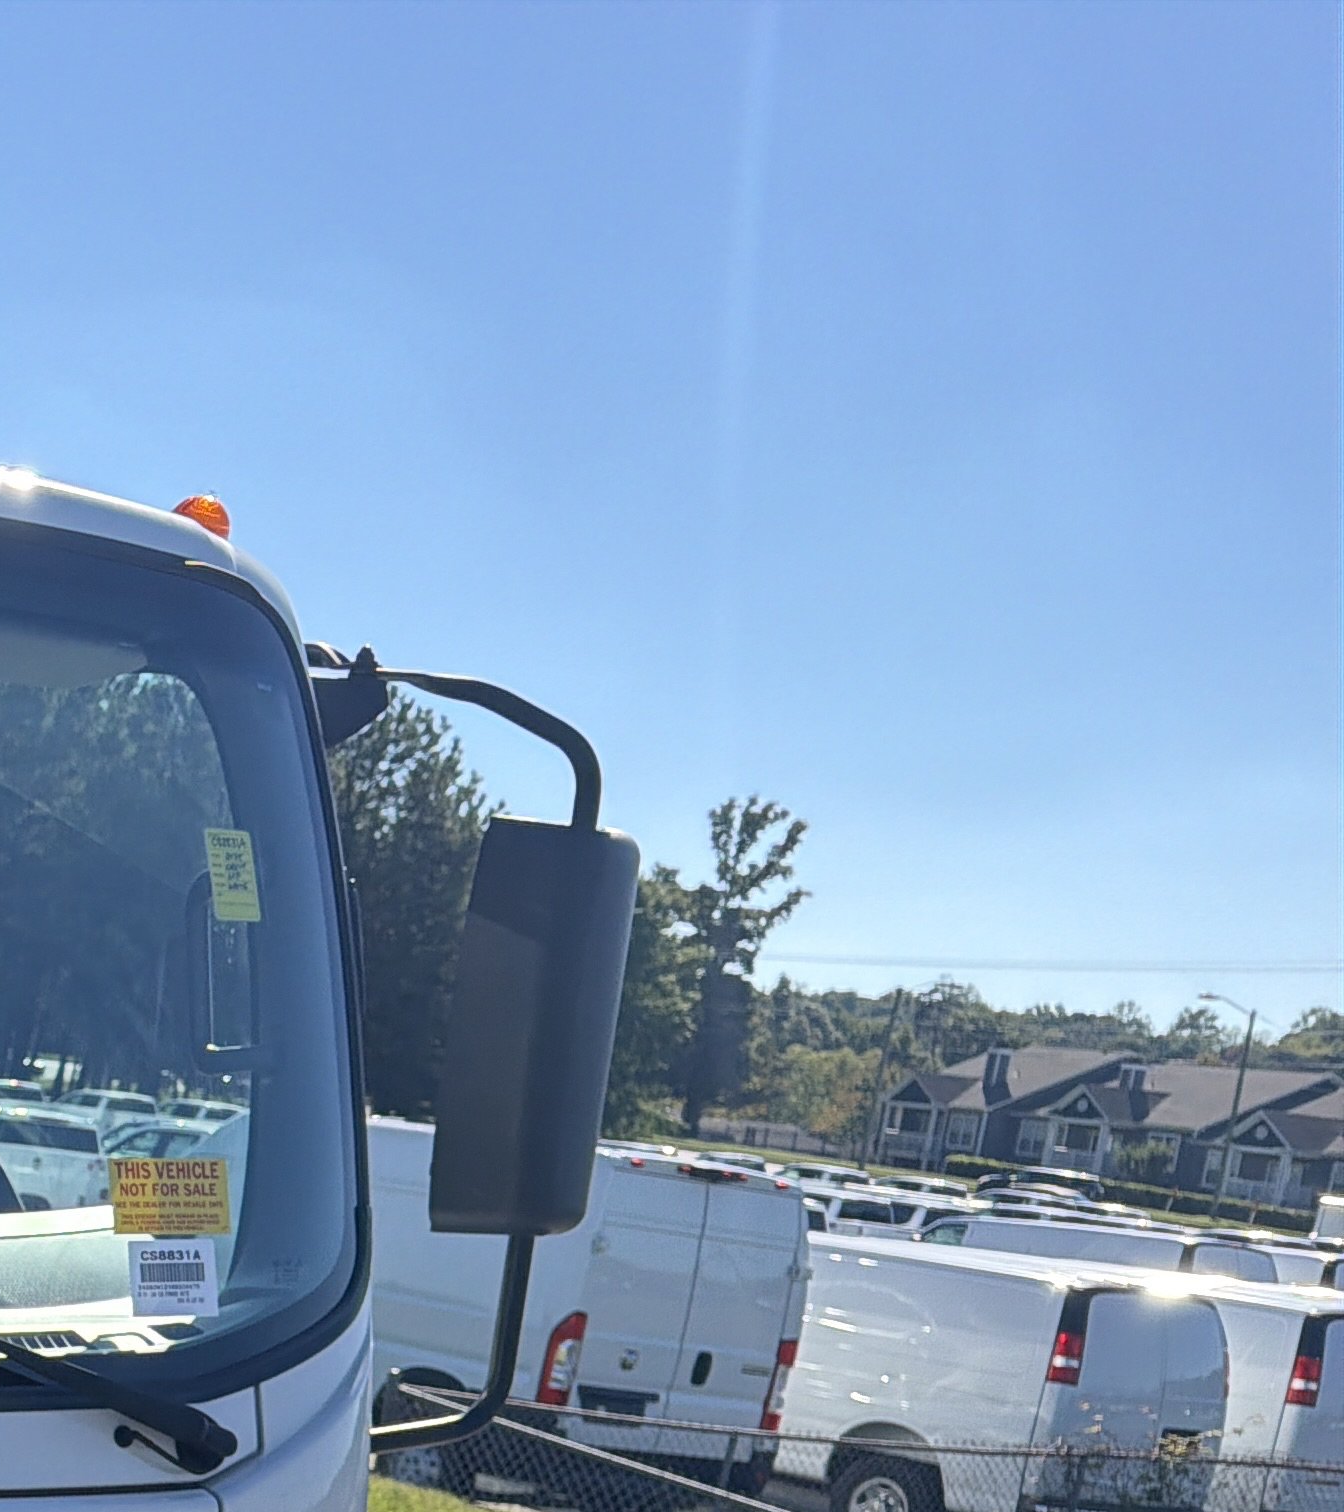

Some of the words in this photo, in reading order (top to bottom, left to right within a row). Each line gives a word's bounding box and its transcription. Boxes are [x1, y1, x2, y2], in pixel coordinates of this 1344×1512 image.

[114, 1161, 151, 1179] THIS
[154, 1161, 219, 1179] VEHICLE
[119, 1183, 147, 1197] NOT
[152, 1183, 179, 1197] FOR
[183, 1183, 217, 1197] SALE
[140, 1250, 201, 1261] CS8831A
